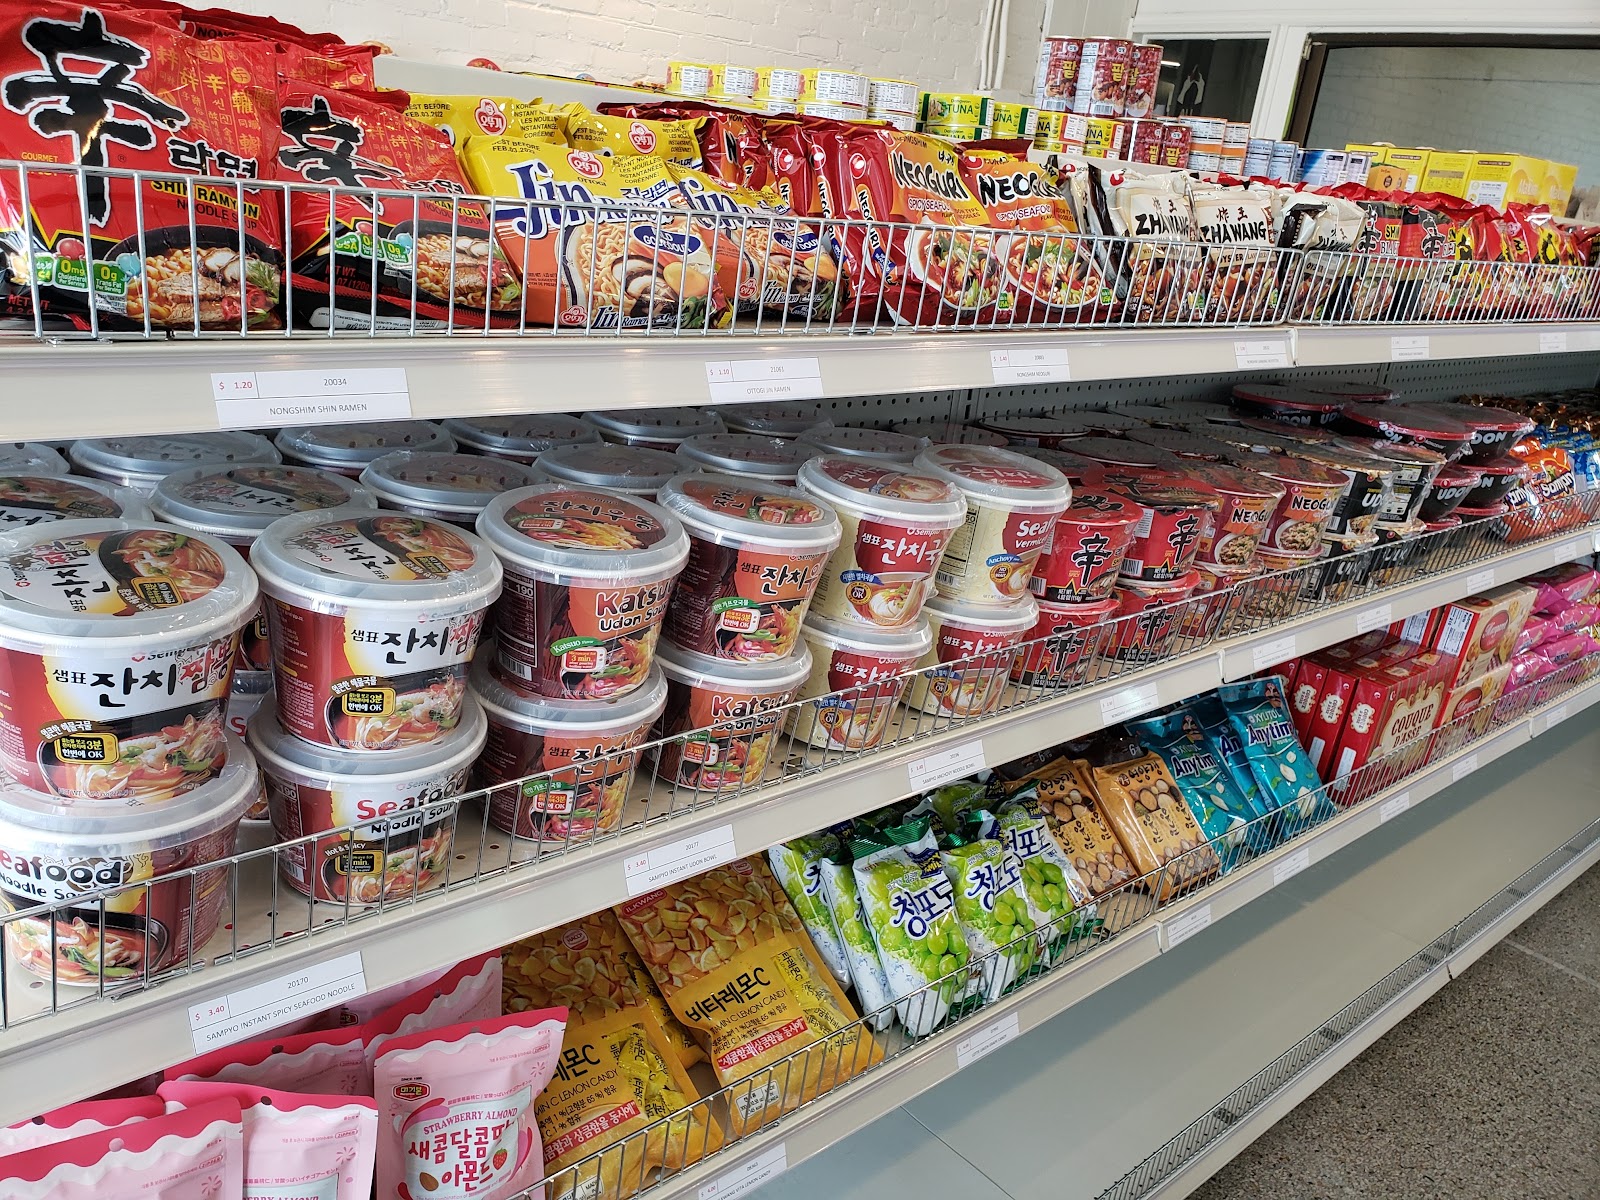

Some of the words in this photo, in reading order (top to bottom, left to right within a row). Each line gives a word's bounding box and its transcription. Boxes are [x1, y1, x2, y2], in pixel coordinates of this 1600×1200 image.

[3, 8, 188, 228] 辛
[946, 103, 974, 115] TUNA
[993, 113, 1013, 126] UNA
[21, 151, 58, 163] GOURMET
[167, 140, 260, 194] 라면
[892, 153, 971, 201] NEOGURI
[1199, 220, 1268, 244] ZHAWANG
[218, 380, 226, 392] $
[233, 380, 254, 391] 1.20
[323, 377, 348, 388] 20034
[268, 405, 317, 418] NONGSHIM
[316, 403, 337, 415] SHIN
[337, 402, 368, 414] RAMEN
[1290, 493, 1337, 515] NEOGU
[1231, 505, 1268, 528] NEOGU
[861, 532, 882, 548] 샘표
[1167, 513, 1201, 565] 辛
[739, 561, 763, 576] 샘표
[1071, 531, 1114, 590] 辛
[515, 582, 534, 599] 190
[598, 612, 642, 634] Udon
[350, 626, 380, 646] 샘표
[551, 639, 583, 655] Katsuo
[942, 634, 962, 648] 샘표
[53, 668, 88, 686] 샘표
[834, 662, 854, 677] 샘표
[369, 703, 384, 713] OK
[1390, 703, 1434, 740] COUQUE
[87, 750, 104, 761] OK
[1171, 752, 1218, 780] Anytim
[0, 850, 124, 887] eafood
[648, 871, 670, 884] SAMPYO
[669, 863, 689, 877] INSTANT
[689, 857, 704, 870] UDON
[703, 853, 719, 866] BOWL
[965, 852, 1026, 913] 청포도
[625, 889, 666, 914] ILKWANG
[286, 976, 310, 991] 20170
[684, 967, 771, 1022] 비타레몬C
[194, 1011, 202, 1024] $
[207, 1004, 226, 1018] 3.40
[205, 1024, 241, 1045] SAMPYO
[239, 1013, 273, 1035] INSTANT
[272, 1006, 293, 1022] SPICY
[292, 994, 328, 1015] SEAFOOD
[327, 983, 357, 1002] NOODLE
[737, 1001, 764, 1020] LEMON
[763, 987, 788, 1008] CANDY
[776, 1002, 789, 1016] 함유
[755, 1028, 786, 1055] 상큼함을
[558, 1082, 592, 1104] LEMON
[589, 1068, 620, 1088] CANDY
[586, 1095, 597, 1105] 65
[604, 1084, 618, 1098] 함유
[423, 1110, 485, 1136] STRAWBERRY
[485, 1107, 519, 1121] ALMOND
[566, 1113, 582, 1128] 함유
[573, 1115, 611, 1144] 상큼함을
[441, 1160, 495, 1195] 아몬드
